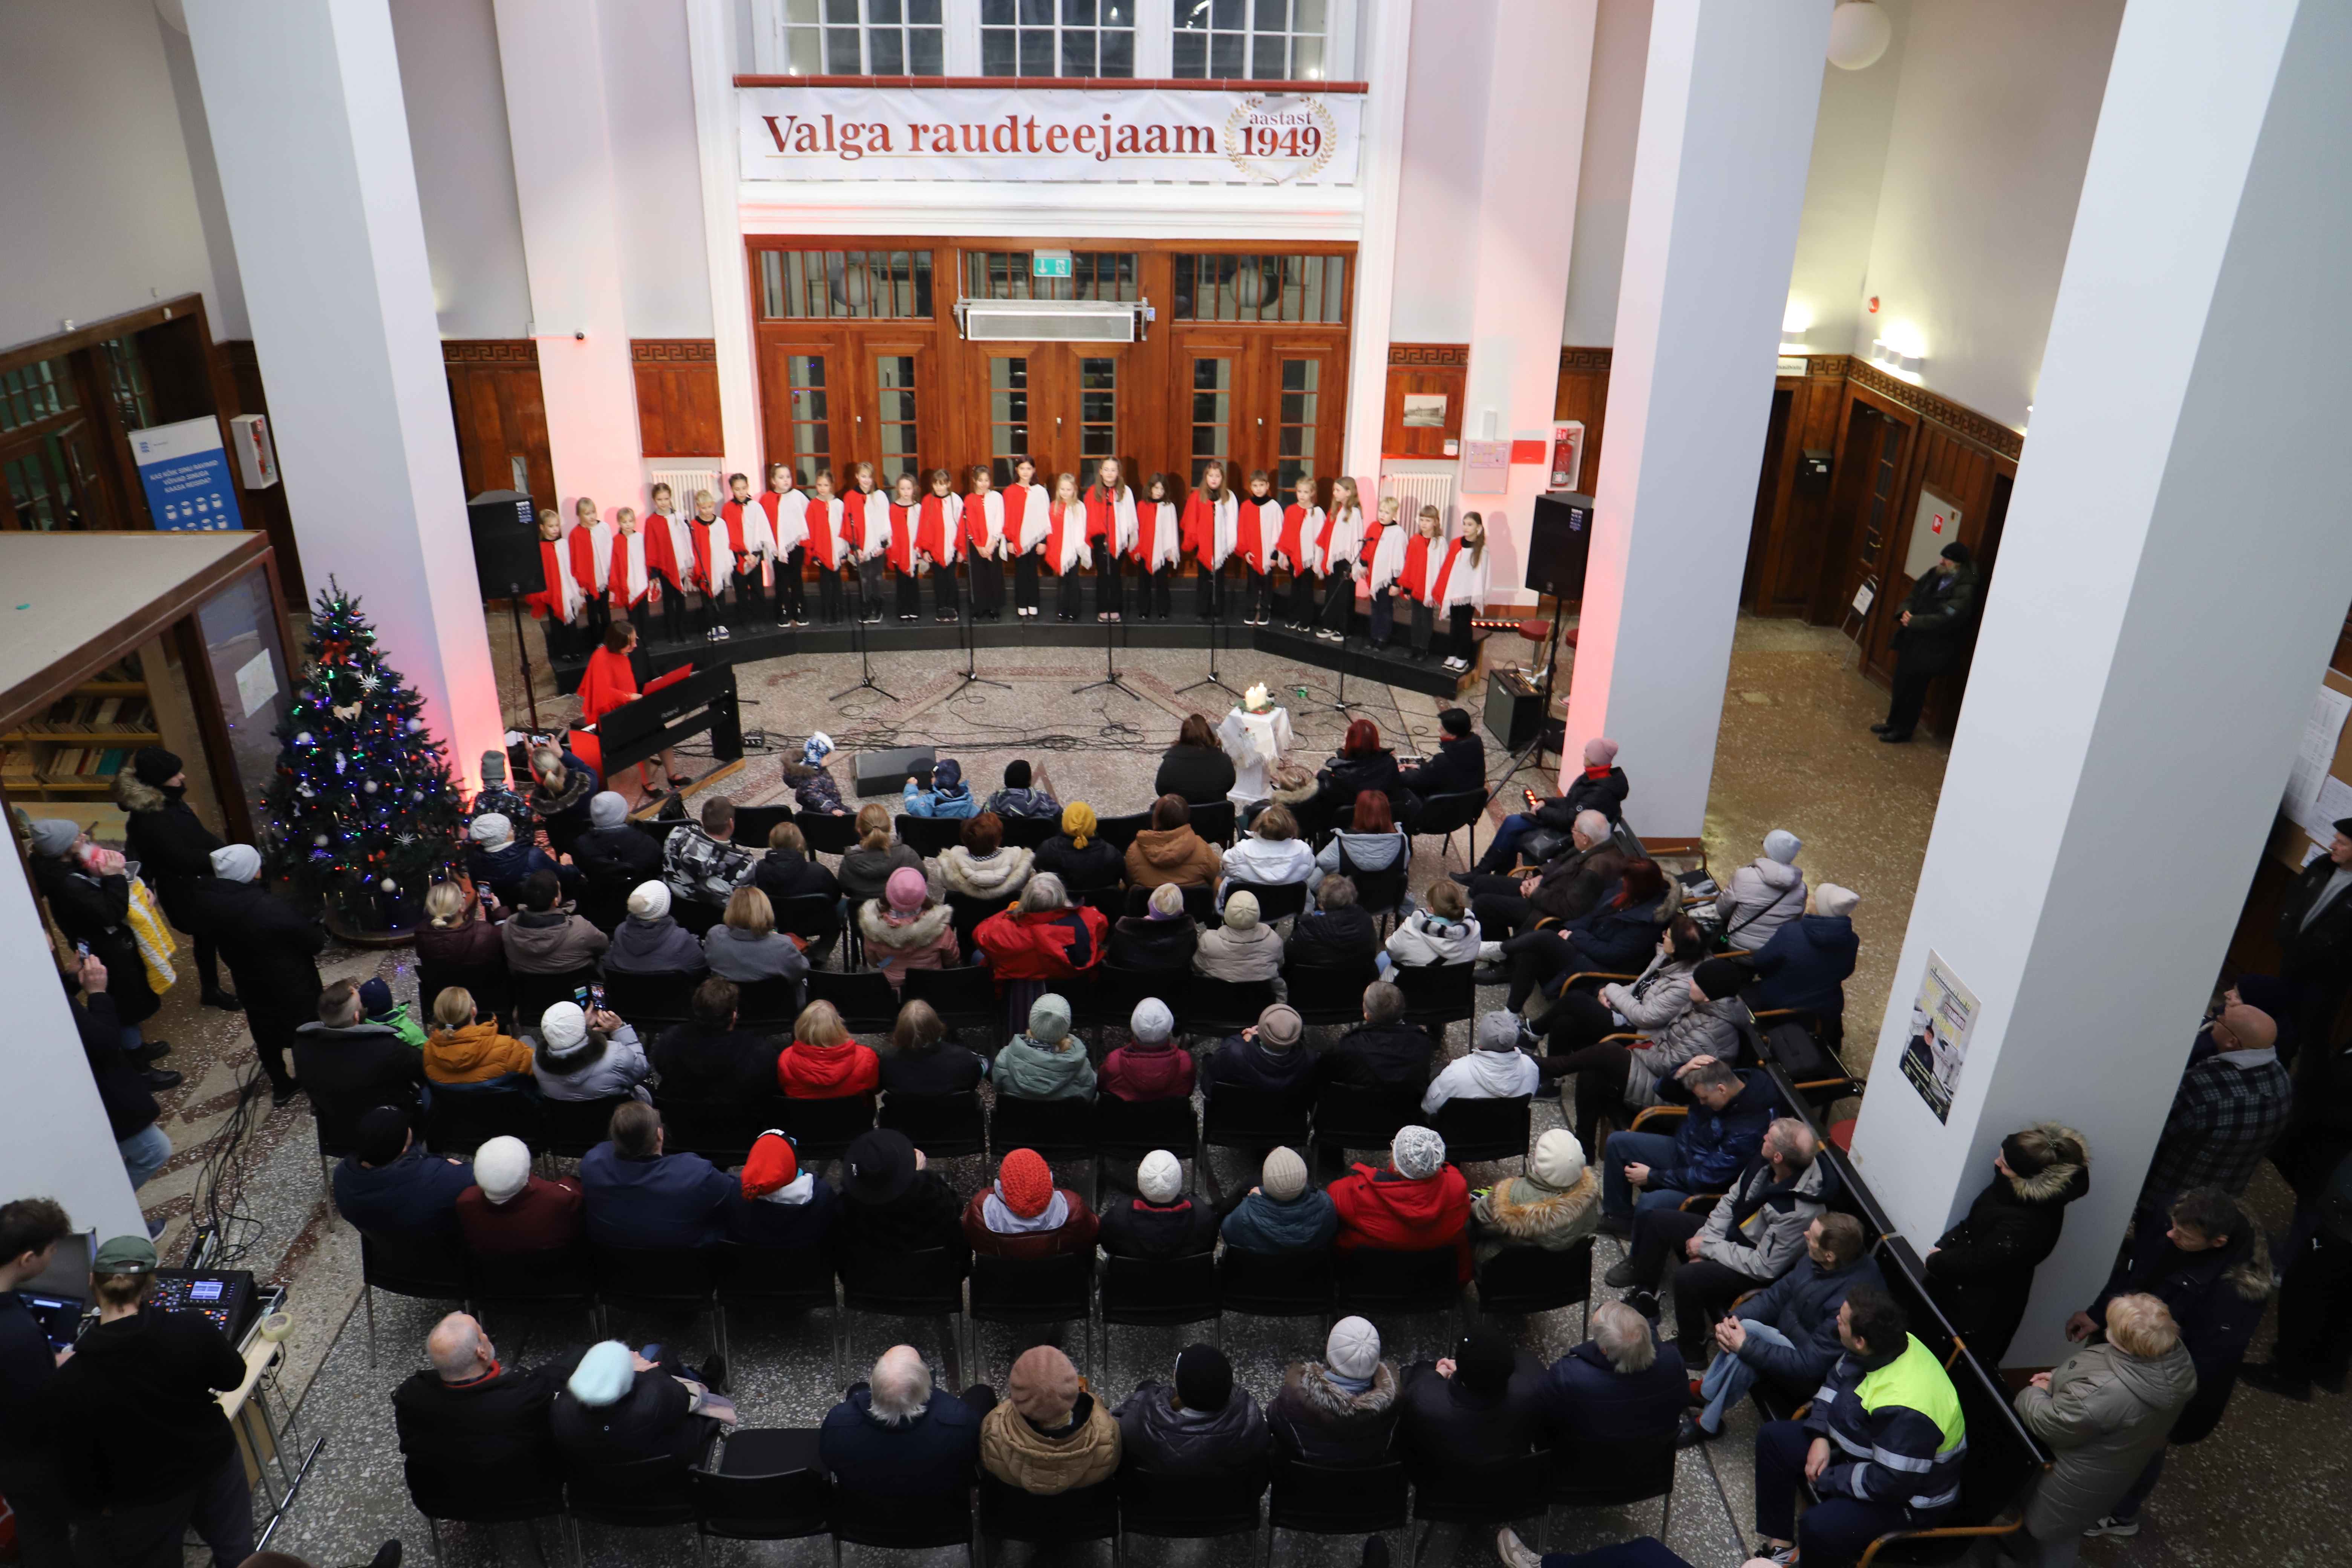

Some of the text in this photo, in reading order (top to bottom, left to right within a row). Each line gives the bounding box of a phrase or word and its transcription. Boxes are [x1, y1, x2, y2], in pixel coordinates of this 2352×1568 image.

[1249, 111, 1312, 125] aastast
[761, 113, 1218, 161] Valga raudteejaam
[1239, 127, 1321, 157] 1949
